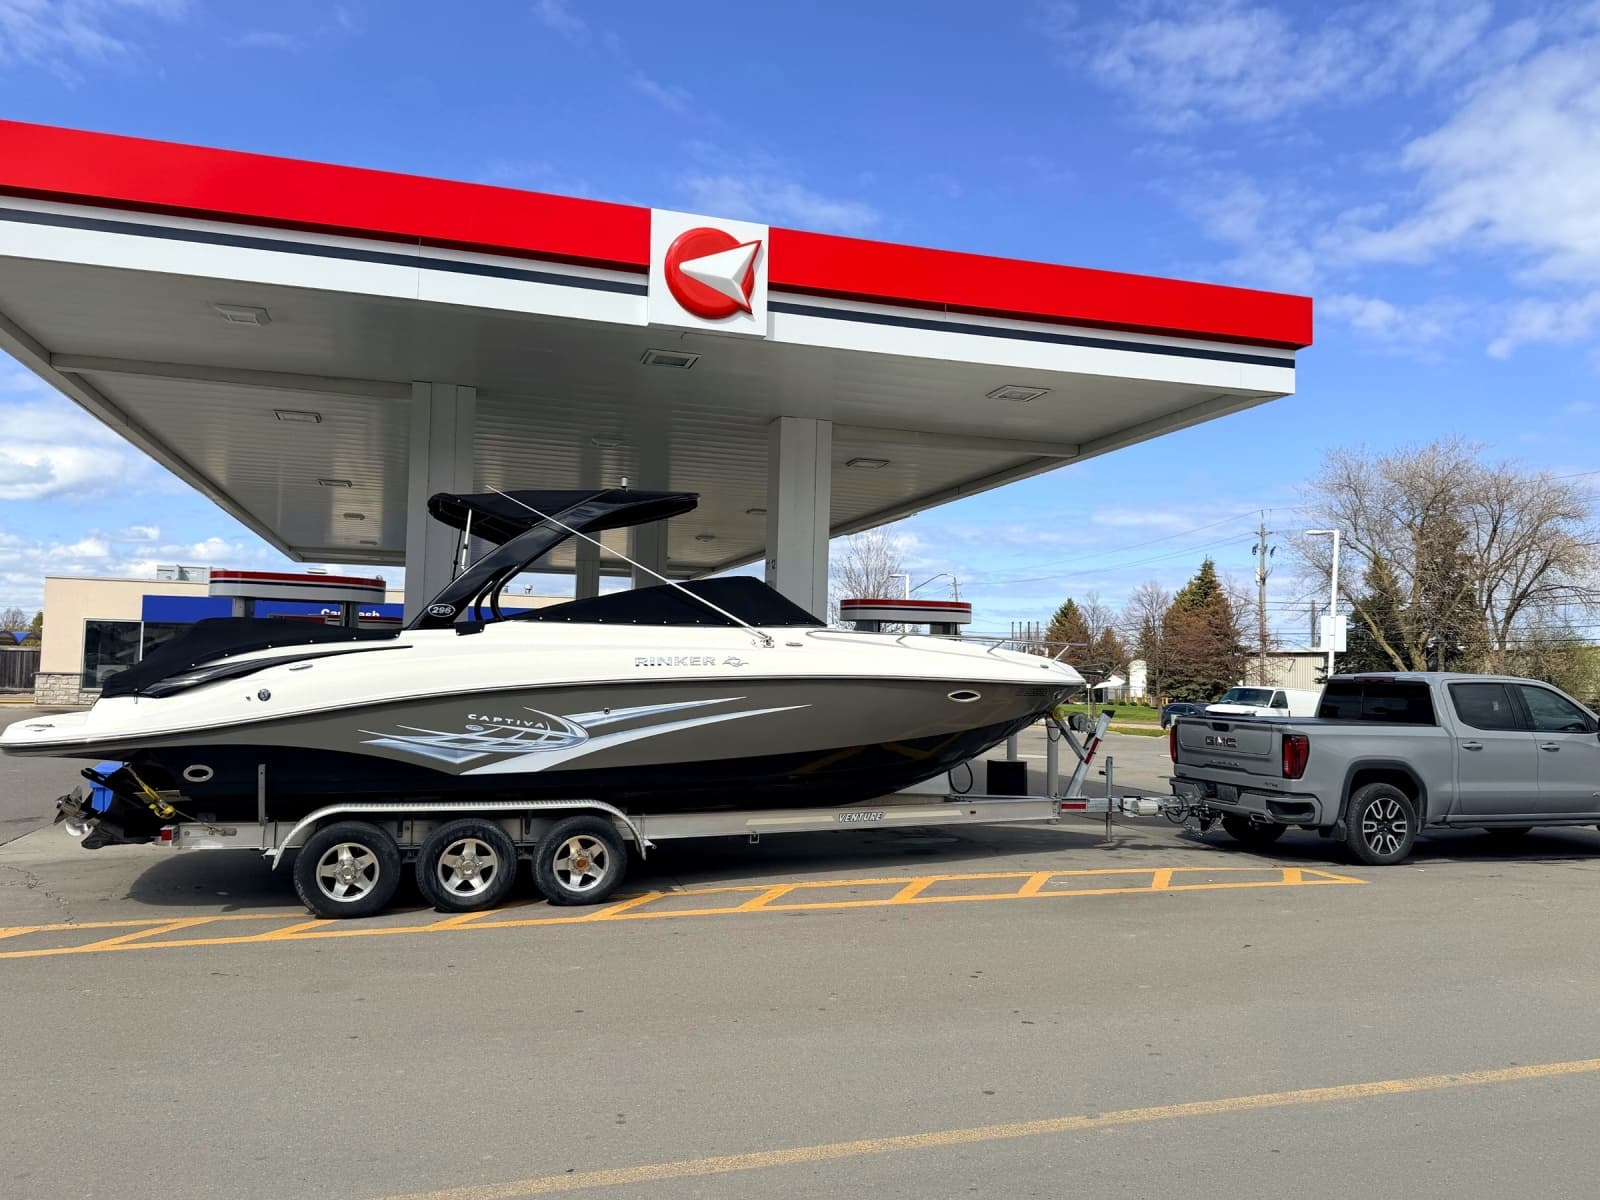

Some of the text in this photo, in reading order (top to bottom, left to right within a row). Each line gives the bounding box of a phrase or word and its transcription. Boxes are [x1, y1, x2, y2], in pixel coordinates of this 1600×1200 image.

[432, 606, 452, 614] 296
[635, 656, 716, 667] RINKER
[467, 713, 545, 729] CAPTIVA
[1205, 736, 1237, 748] GMC
[839, 812, 883, 822] VENTURE
